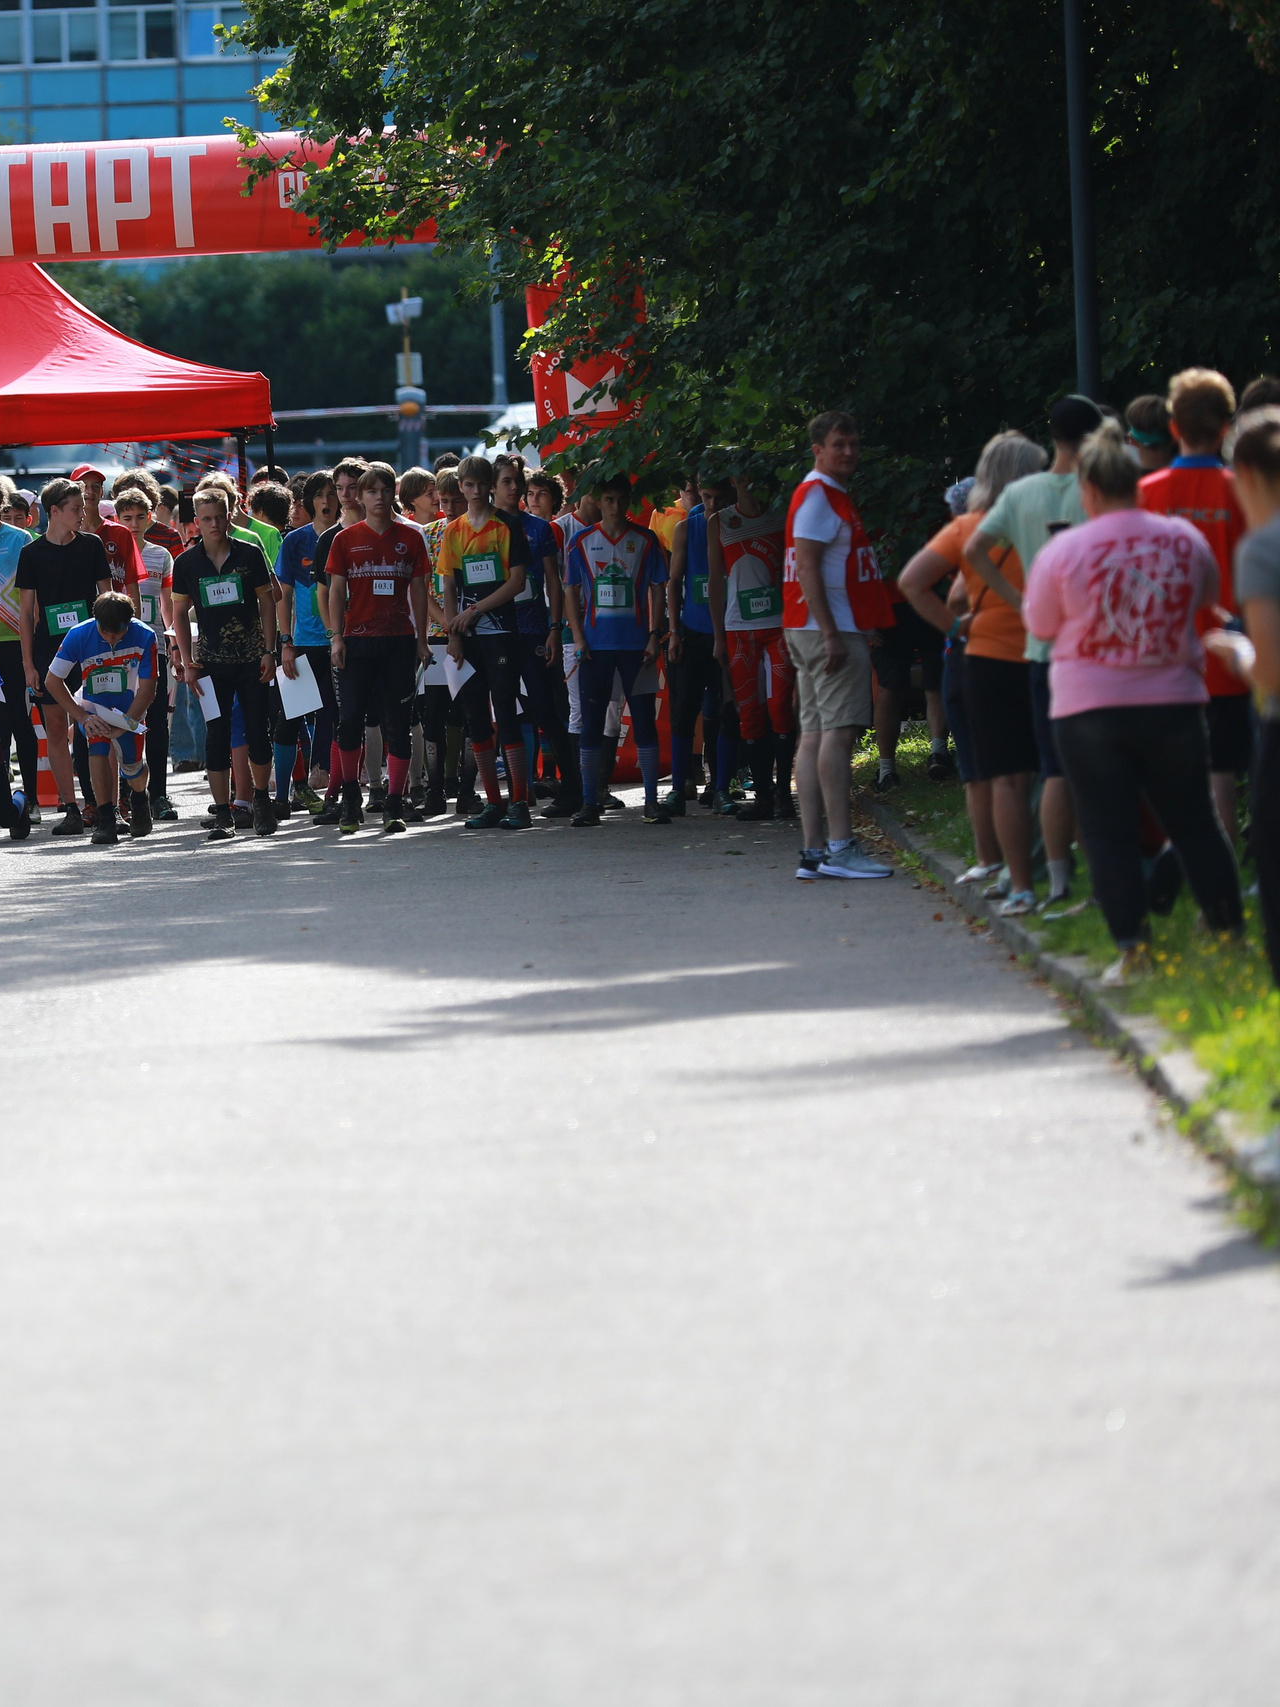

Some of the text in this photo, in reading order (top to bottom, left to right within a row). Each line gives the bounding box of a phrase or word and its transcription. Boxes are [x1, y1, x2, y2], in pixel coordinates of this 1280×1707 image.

[750, 541, 768, 554] Run
[472, 564, 489, 572] 102.1
[374, 582, 392, 590] 103.1
[212, 587, 231, 596] 104.1
[751, 599, 770, 608] 100.1
[59, 614, 76, 623] 115.1
